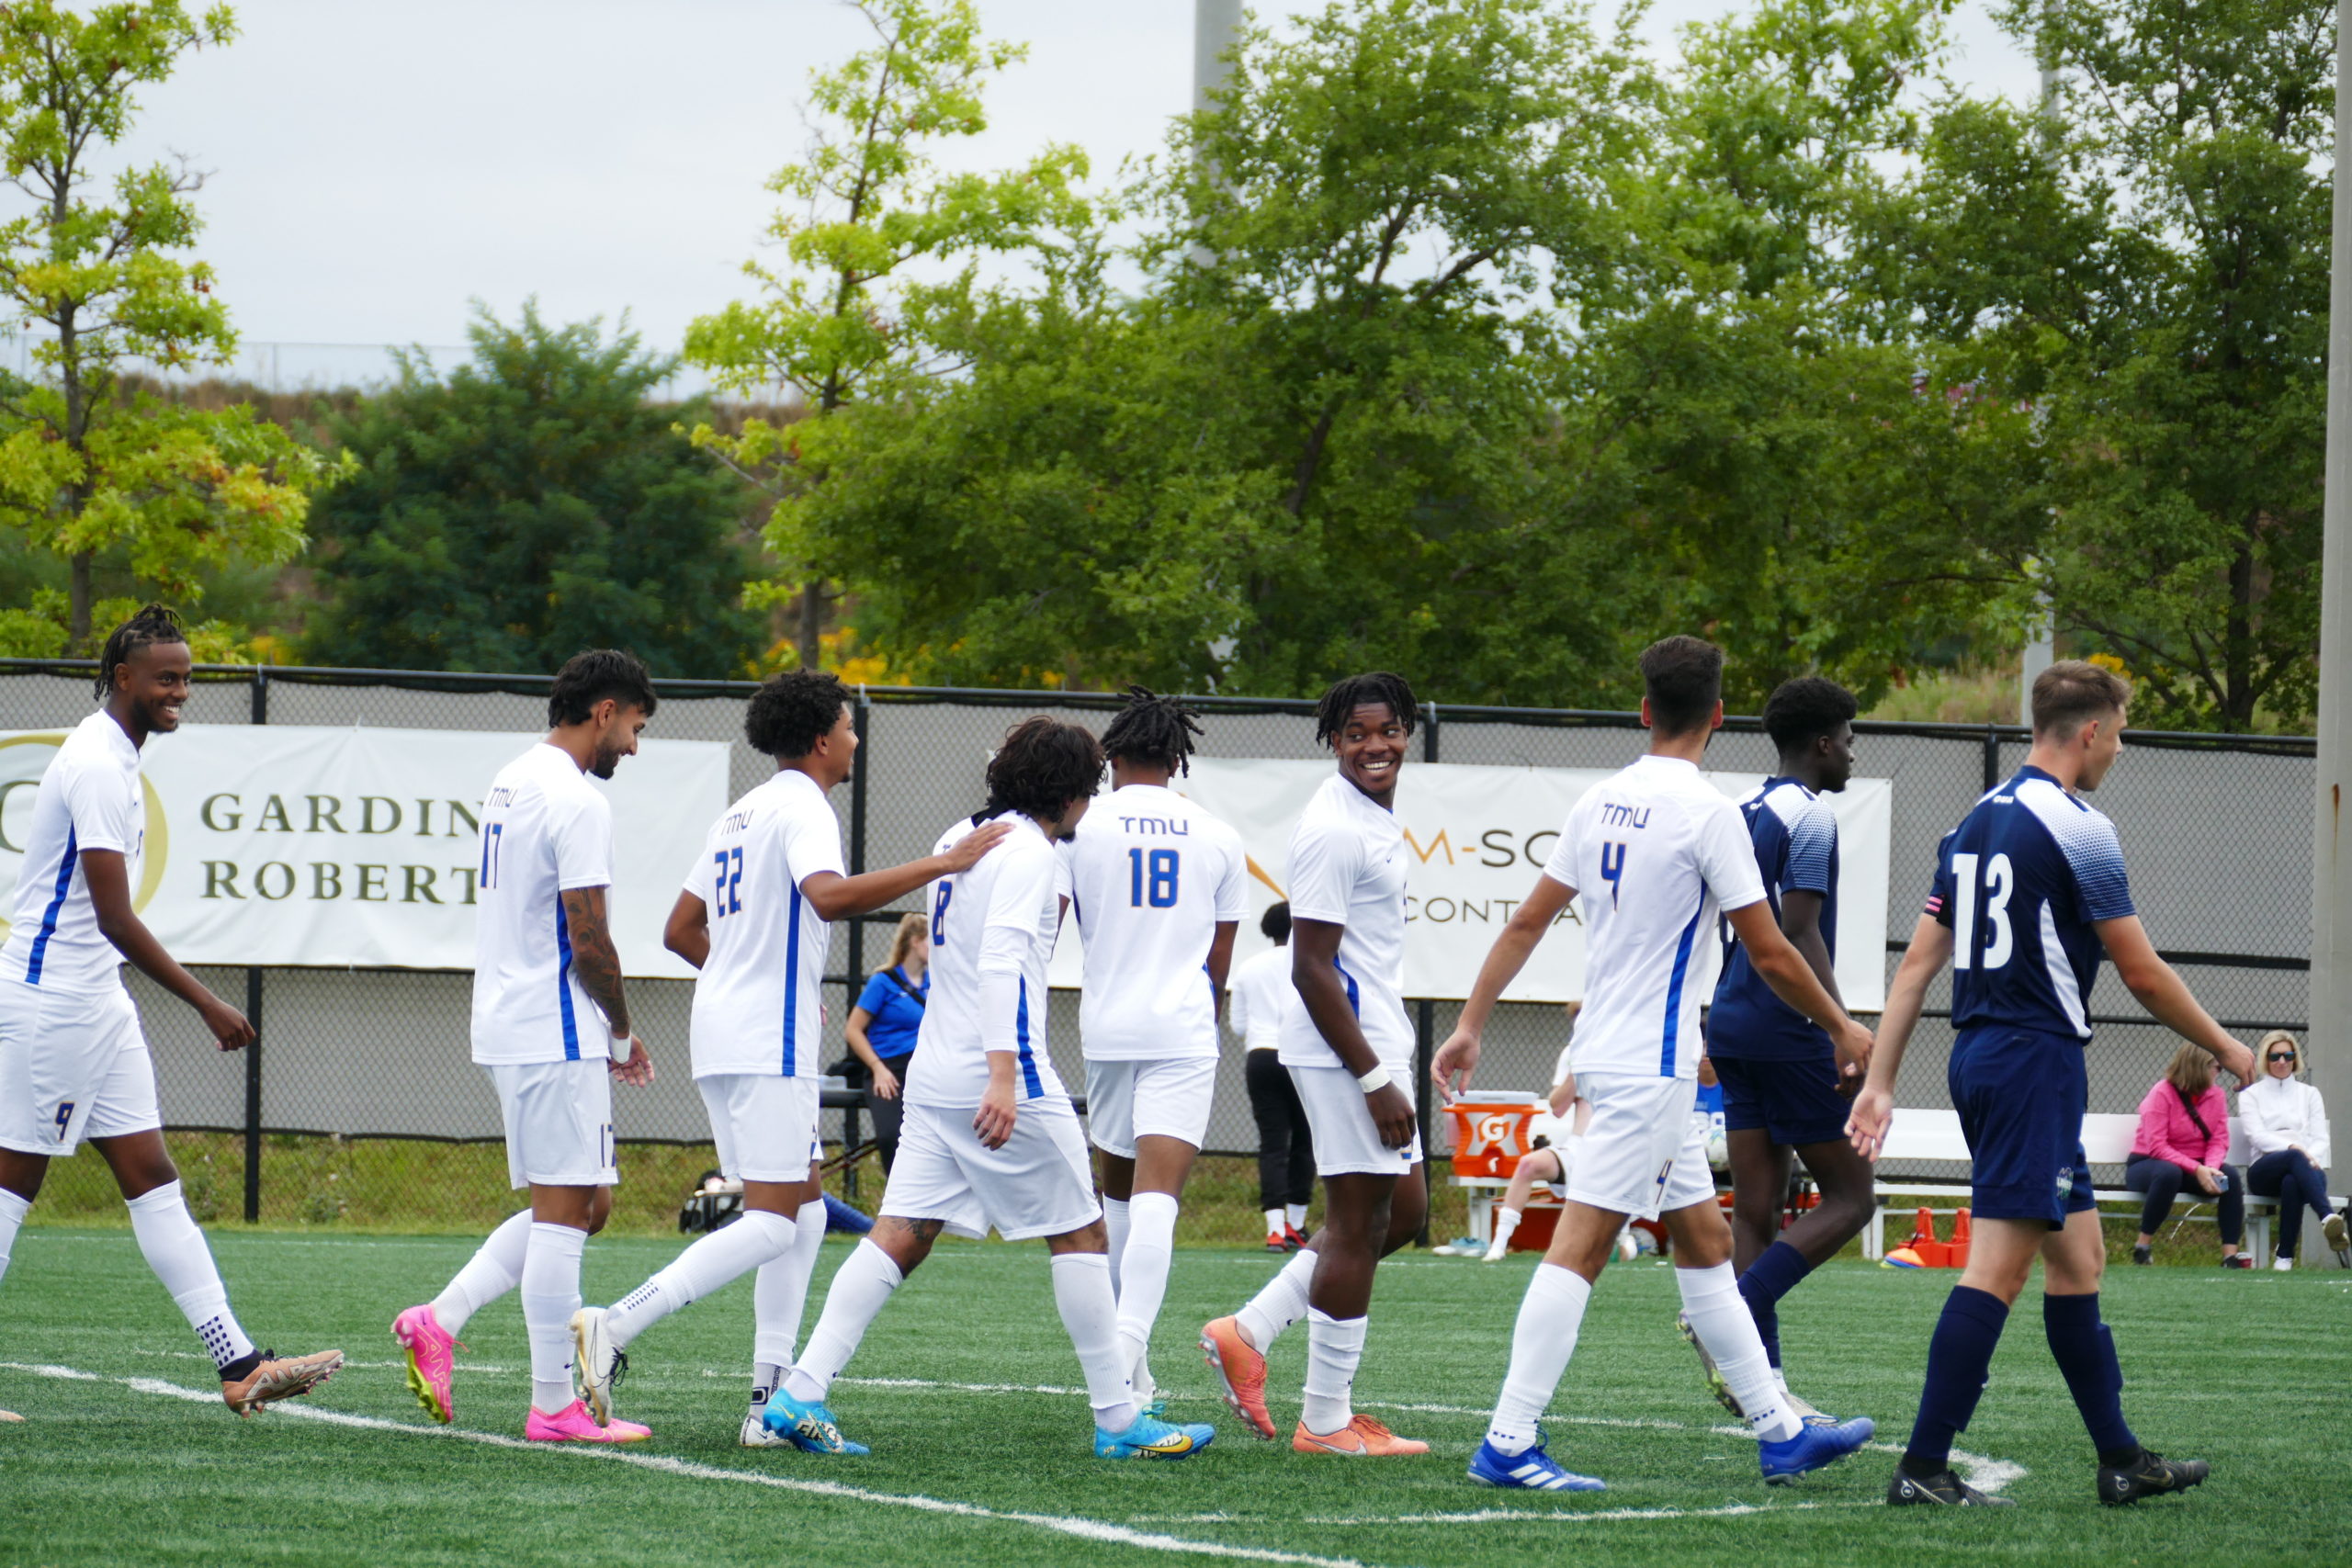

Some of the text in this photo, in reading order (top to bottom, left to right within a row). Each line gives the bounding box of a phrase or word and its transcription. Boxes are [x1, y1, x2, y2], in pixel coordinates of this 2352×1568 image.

[200, 793, 482, 837] GARDIN
[489, 787, 517, 807] TMU
[1601, 803, 1651, 829] TMU
[721, 808, 753, 836] TMU
[1119, 816, 1188, 836] TMU
[480, 822, 503, 889] 17
[1600, 840, 1626, 912] 4
[199, 860, 479, 905] ROBERT
[714, 845, 742, 919] 22
[1127, 847, 1181, 909] 18
[932, 879, 953, 947] 8
[1407, 895, 1583, 926] ONTA
[1951, 852, 2014, 969] 13
[55, 1100, 75, 1143] 9
[1480, 1115, 1507, 1142] G
[1655, 1158, 1673, 1205] 4
